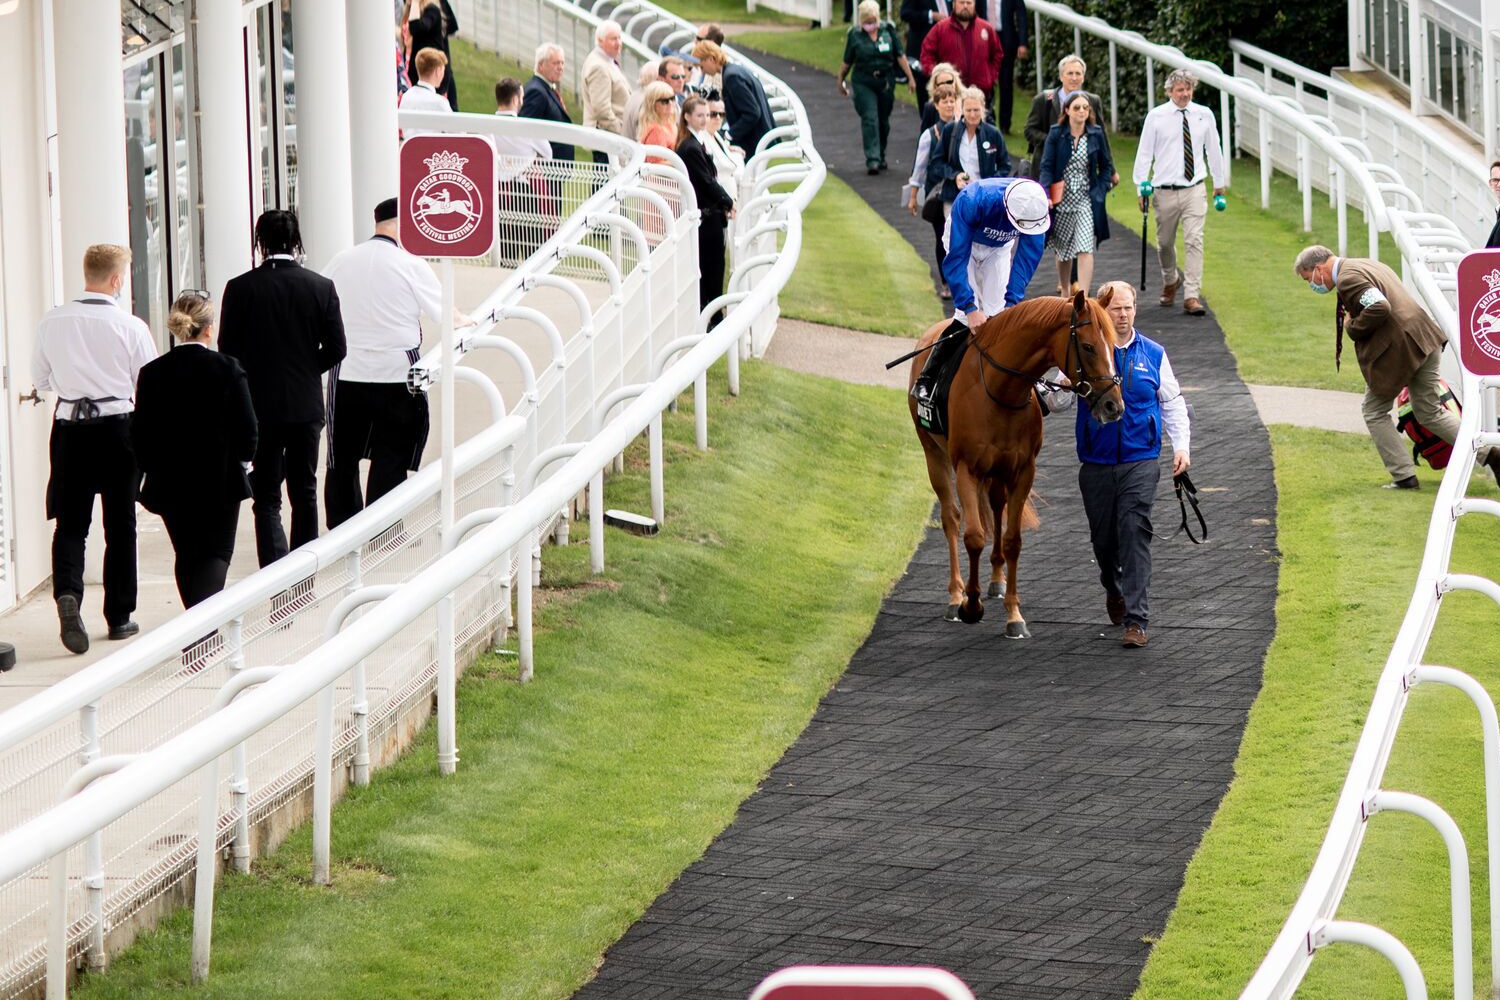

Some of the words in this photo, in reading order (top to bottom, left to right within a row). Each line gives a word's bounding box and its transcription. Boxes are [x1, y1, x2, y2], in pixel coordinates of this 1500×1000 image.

[419, 175, 438, 192] QATAR
[438, 173, 473, 192] GOODWOOD
[419, 222, 447, 241] FESTIVAL
[447, 222, 474, 241] MEETING
[983, 227, 1021, 237] Emirate
[1479, 293, 1498, 309] QATAR
